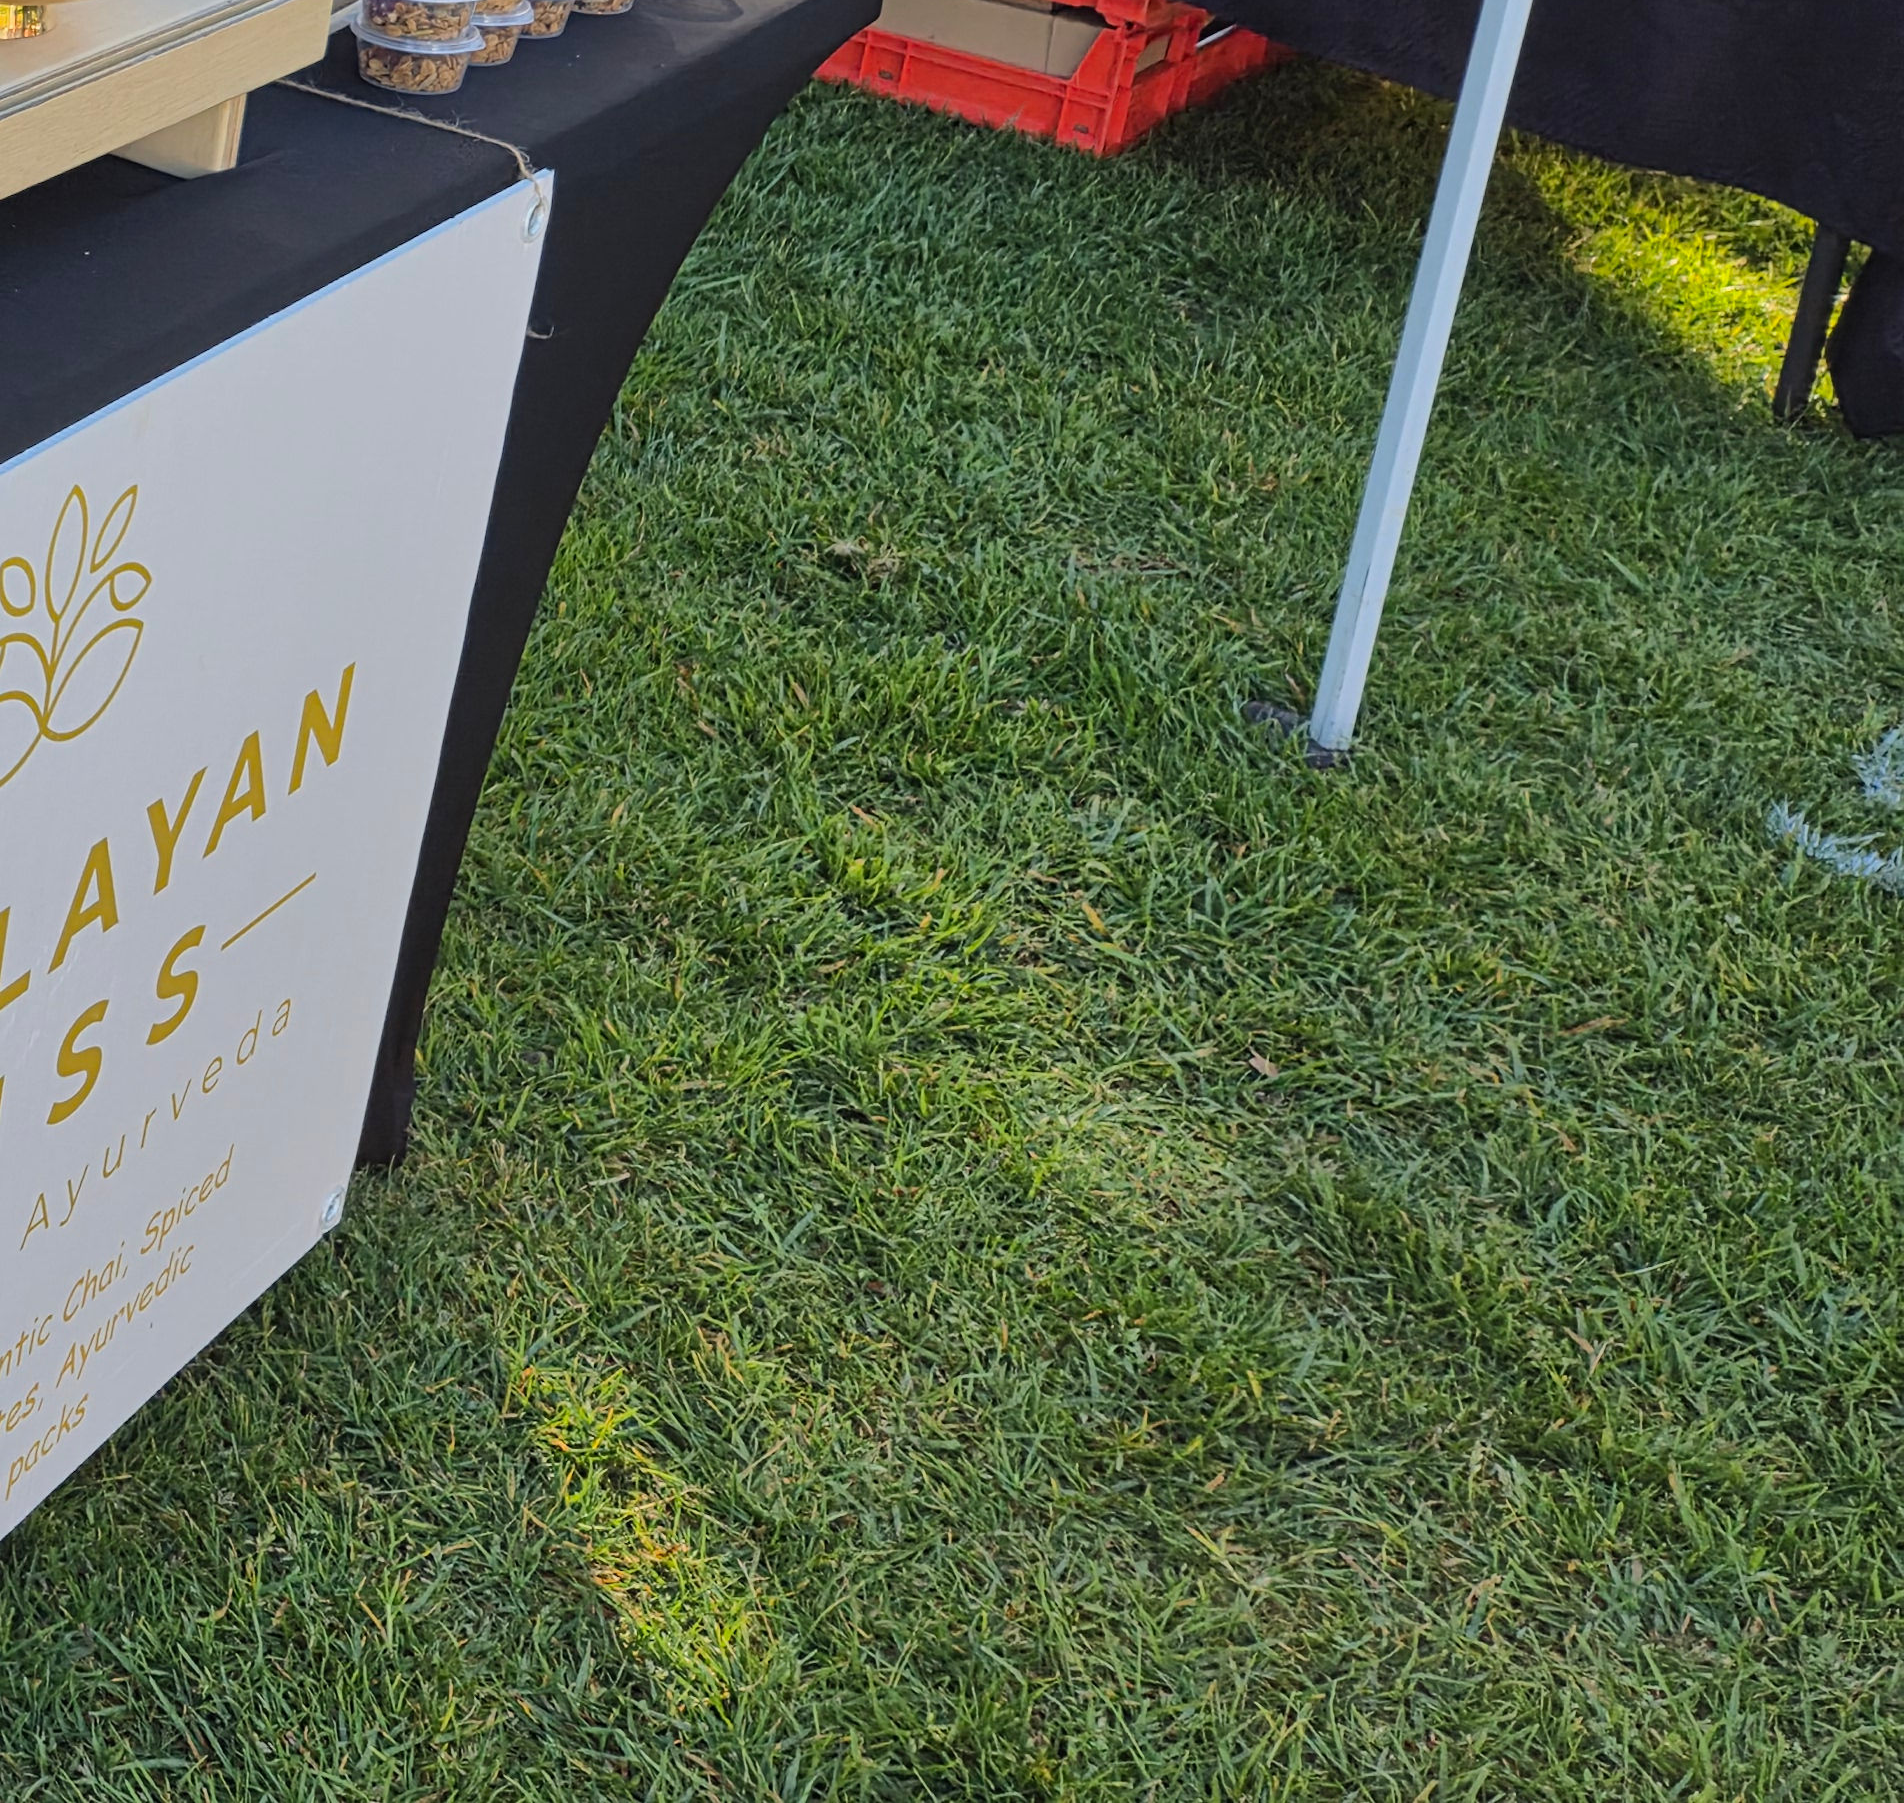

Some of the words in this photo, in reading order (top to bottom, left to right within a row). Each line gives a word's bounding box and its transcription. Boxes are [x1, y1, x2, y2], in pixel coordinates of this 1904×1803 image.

[20, 998, 292, 1251] Ayurveda
[62, 1240, 130, 1323] Chai,
[140, 1142, 235, 1259] Spiced
[56, 1245, 194, 1389] Ayurvedic
[5, 1391, 90, 1500] packs
